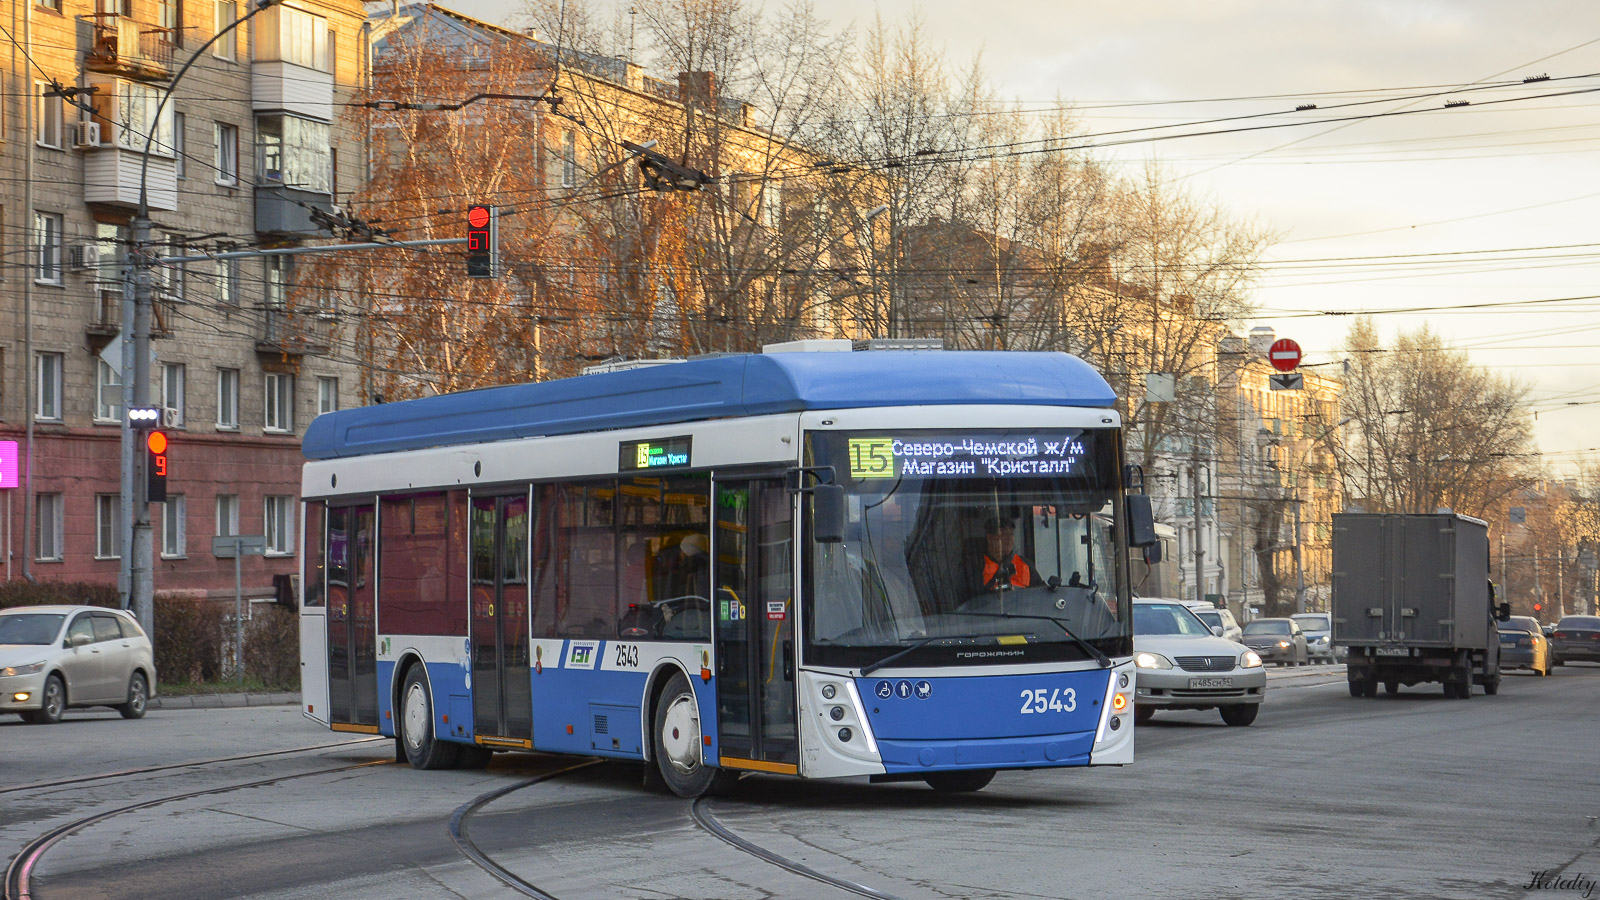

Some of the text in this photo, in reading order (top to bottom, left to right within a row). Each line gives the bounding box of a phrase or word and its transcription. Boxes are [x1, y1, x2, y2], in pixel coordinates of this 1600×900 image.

[468, 230, 489, 250] 67
[638, 447, 648, 465] 15
[851, 436, 1084, 473] 15 Северо-Чемской ж/м
[155, 455, 167, 476] 9
[902, 456, 1076, 477] Магазин "Кристалл"
[615, 644, 639, 667] 2543
[956, 650, 1025, 658] ГОРОЖАНИН
[1020, 687, 1077, 714] 2543
